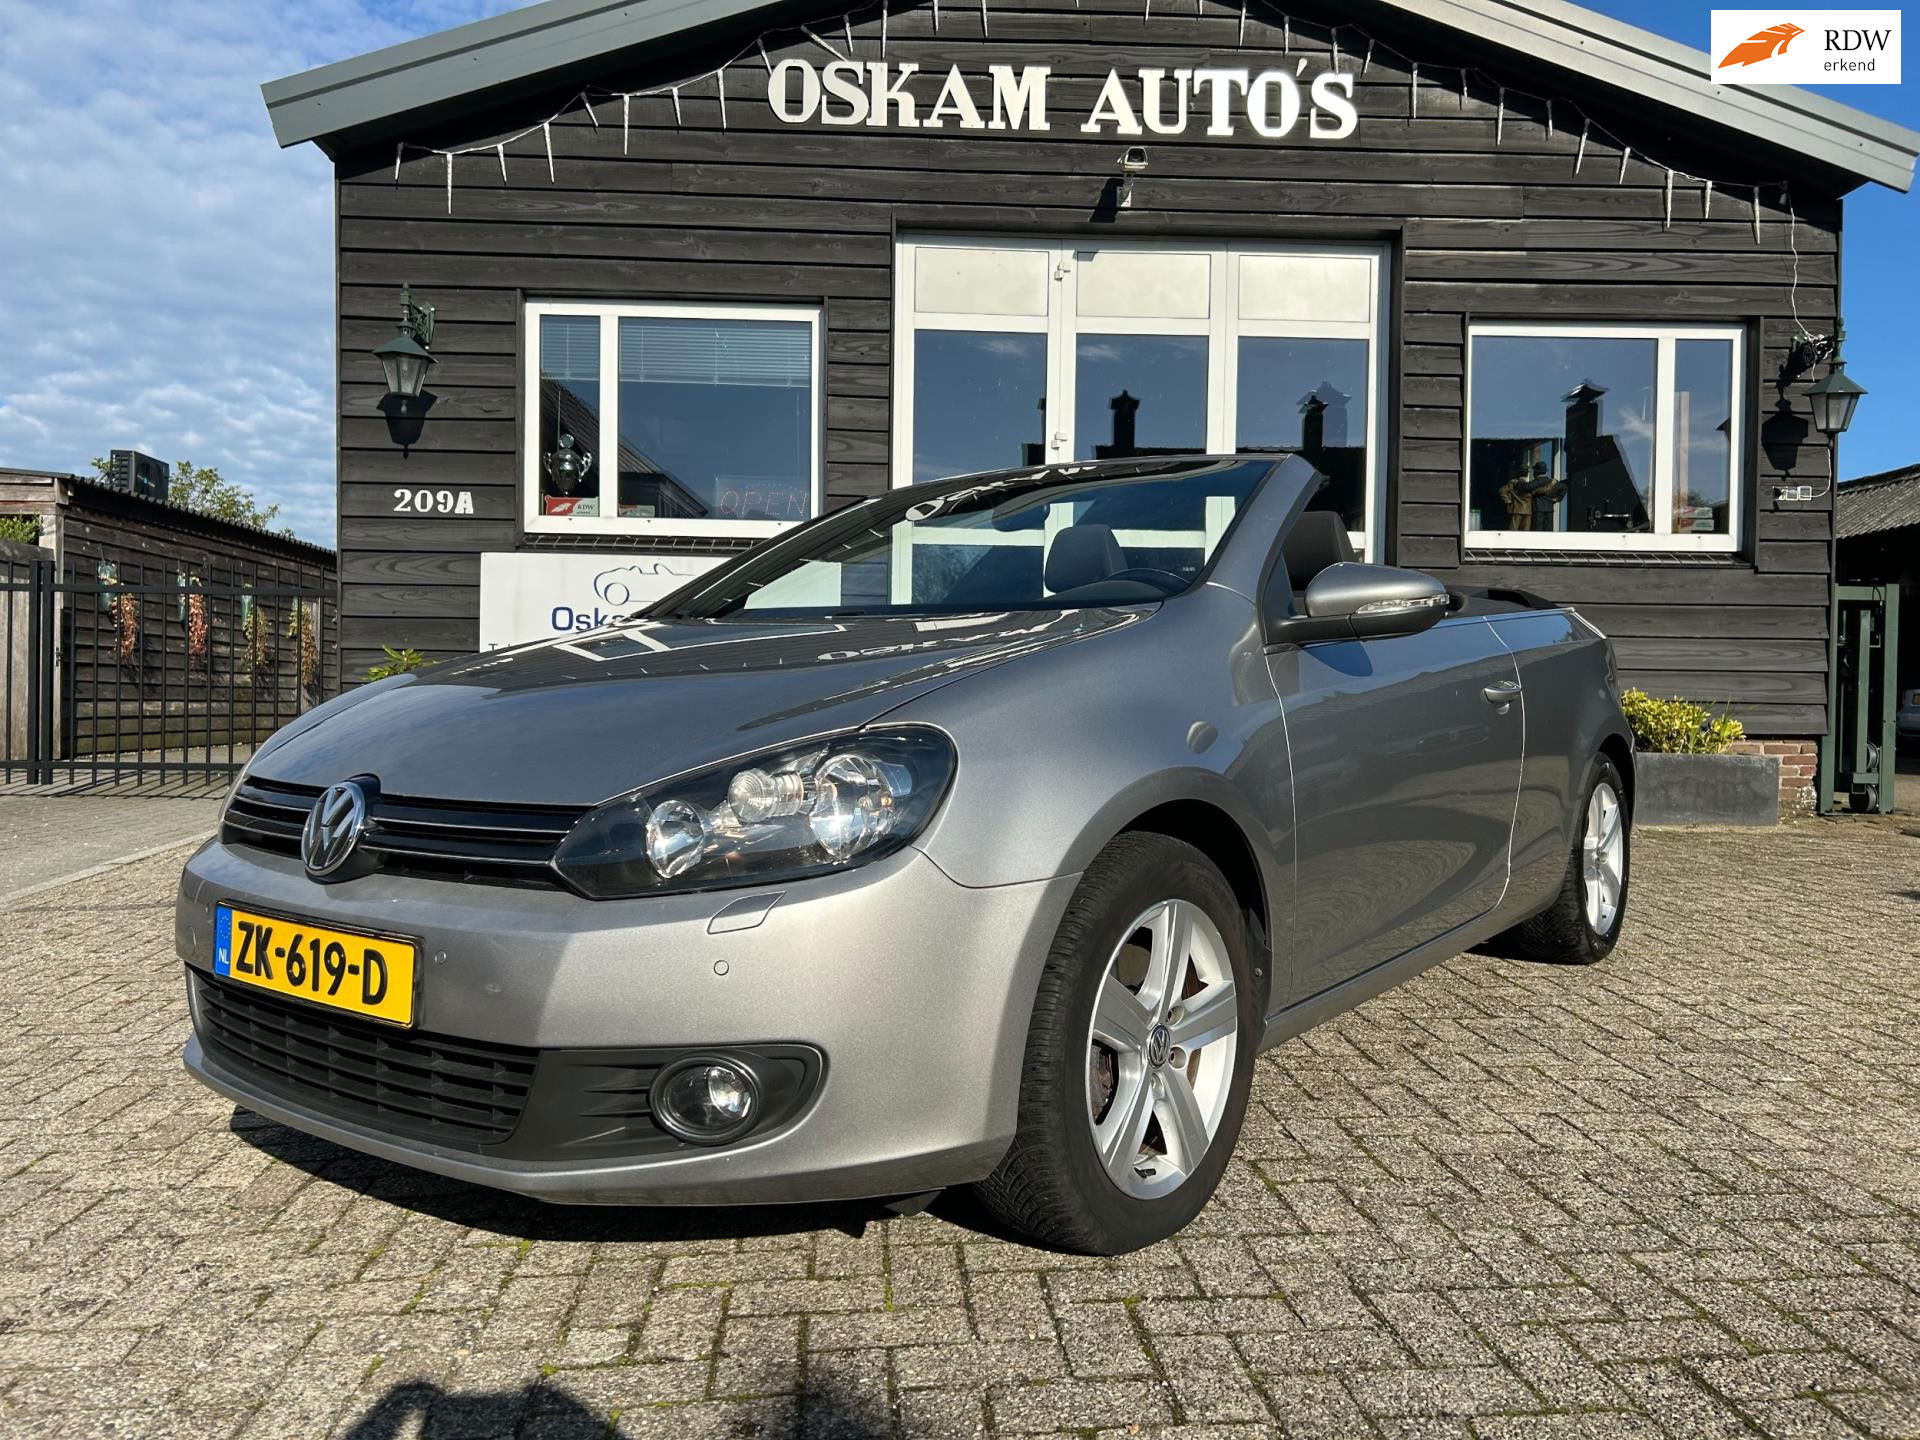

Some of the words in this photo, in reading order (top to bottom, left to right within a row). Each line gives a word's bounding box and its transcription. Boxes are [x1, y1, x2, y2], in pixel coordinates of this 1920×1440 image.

[768, 58, 1051, 131] OSKAM
[393, 488, 474, 514] 209A
[720, 490, 807, 517] OPEN
[218, 948, 229, 964] NL
[236, 920, 388, 1005] ZK-619-D
